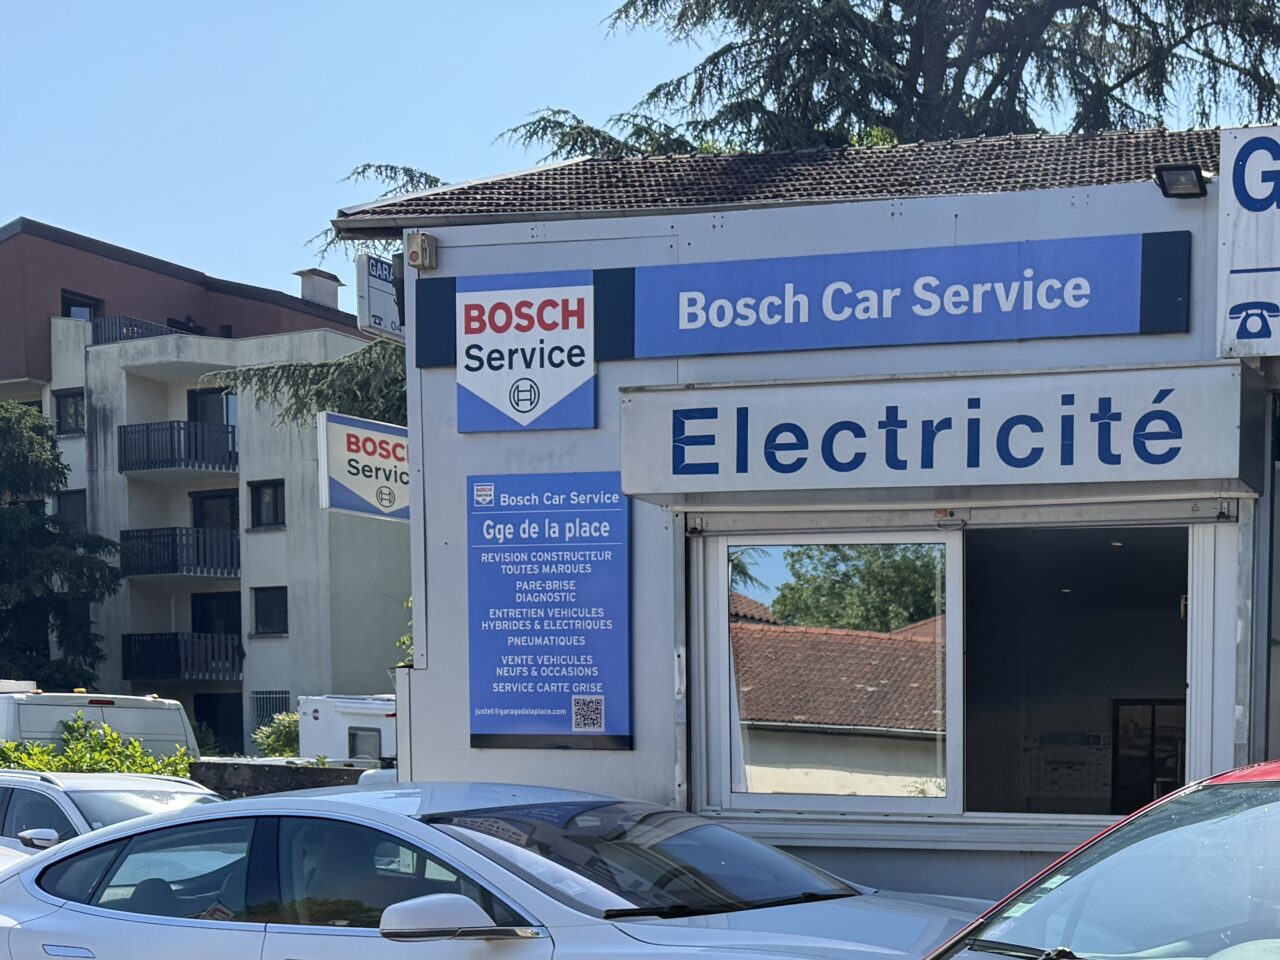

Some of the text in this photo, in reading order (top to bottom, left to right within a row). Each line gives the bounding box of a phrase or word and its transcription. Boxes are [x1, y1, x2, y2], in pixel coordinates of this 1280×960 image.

[678, 267, 1091, 330] Bosch Car Service
[463, 297, 585, 336] BOSCH
[464, 340, 586, 373] Service
[671, 388, 1184, 477] Electricité
[346, 432, 409, 462] BOSC
[500, 490, 620, 506] Bosch Car Service
[482, 517, 610, 544] Gge de la place
[481, 550, 612, 563] REVISION CONSTRUCTEUR
[500, 563, 592, 575] TOUTES MARQUES
[516, 580, 576, 591] PARE-BRISE
[515, 591, 577, 603] DIAGNOSTIC
[489, 607, 605, 619] ENTRETIEN VEHICULES
[481, 619, 613, 631] HYBRIDES & ELECTRIQUES
[507, 635, 586, 646] PNEUMATIQUES
[501, 654, 594, 665] VENTE VEHICULES
[495, 666, 599, 677] NEUFS & OCCASIONS
[492, 682, 604, 693] SERVICE CARTE GRISE
